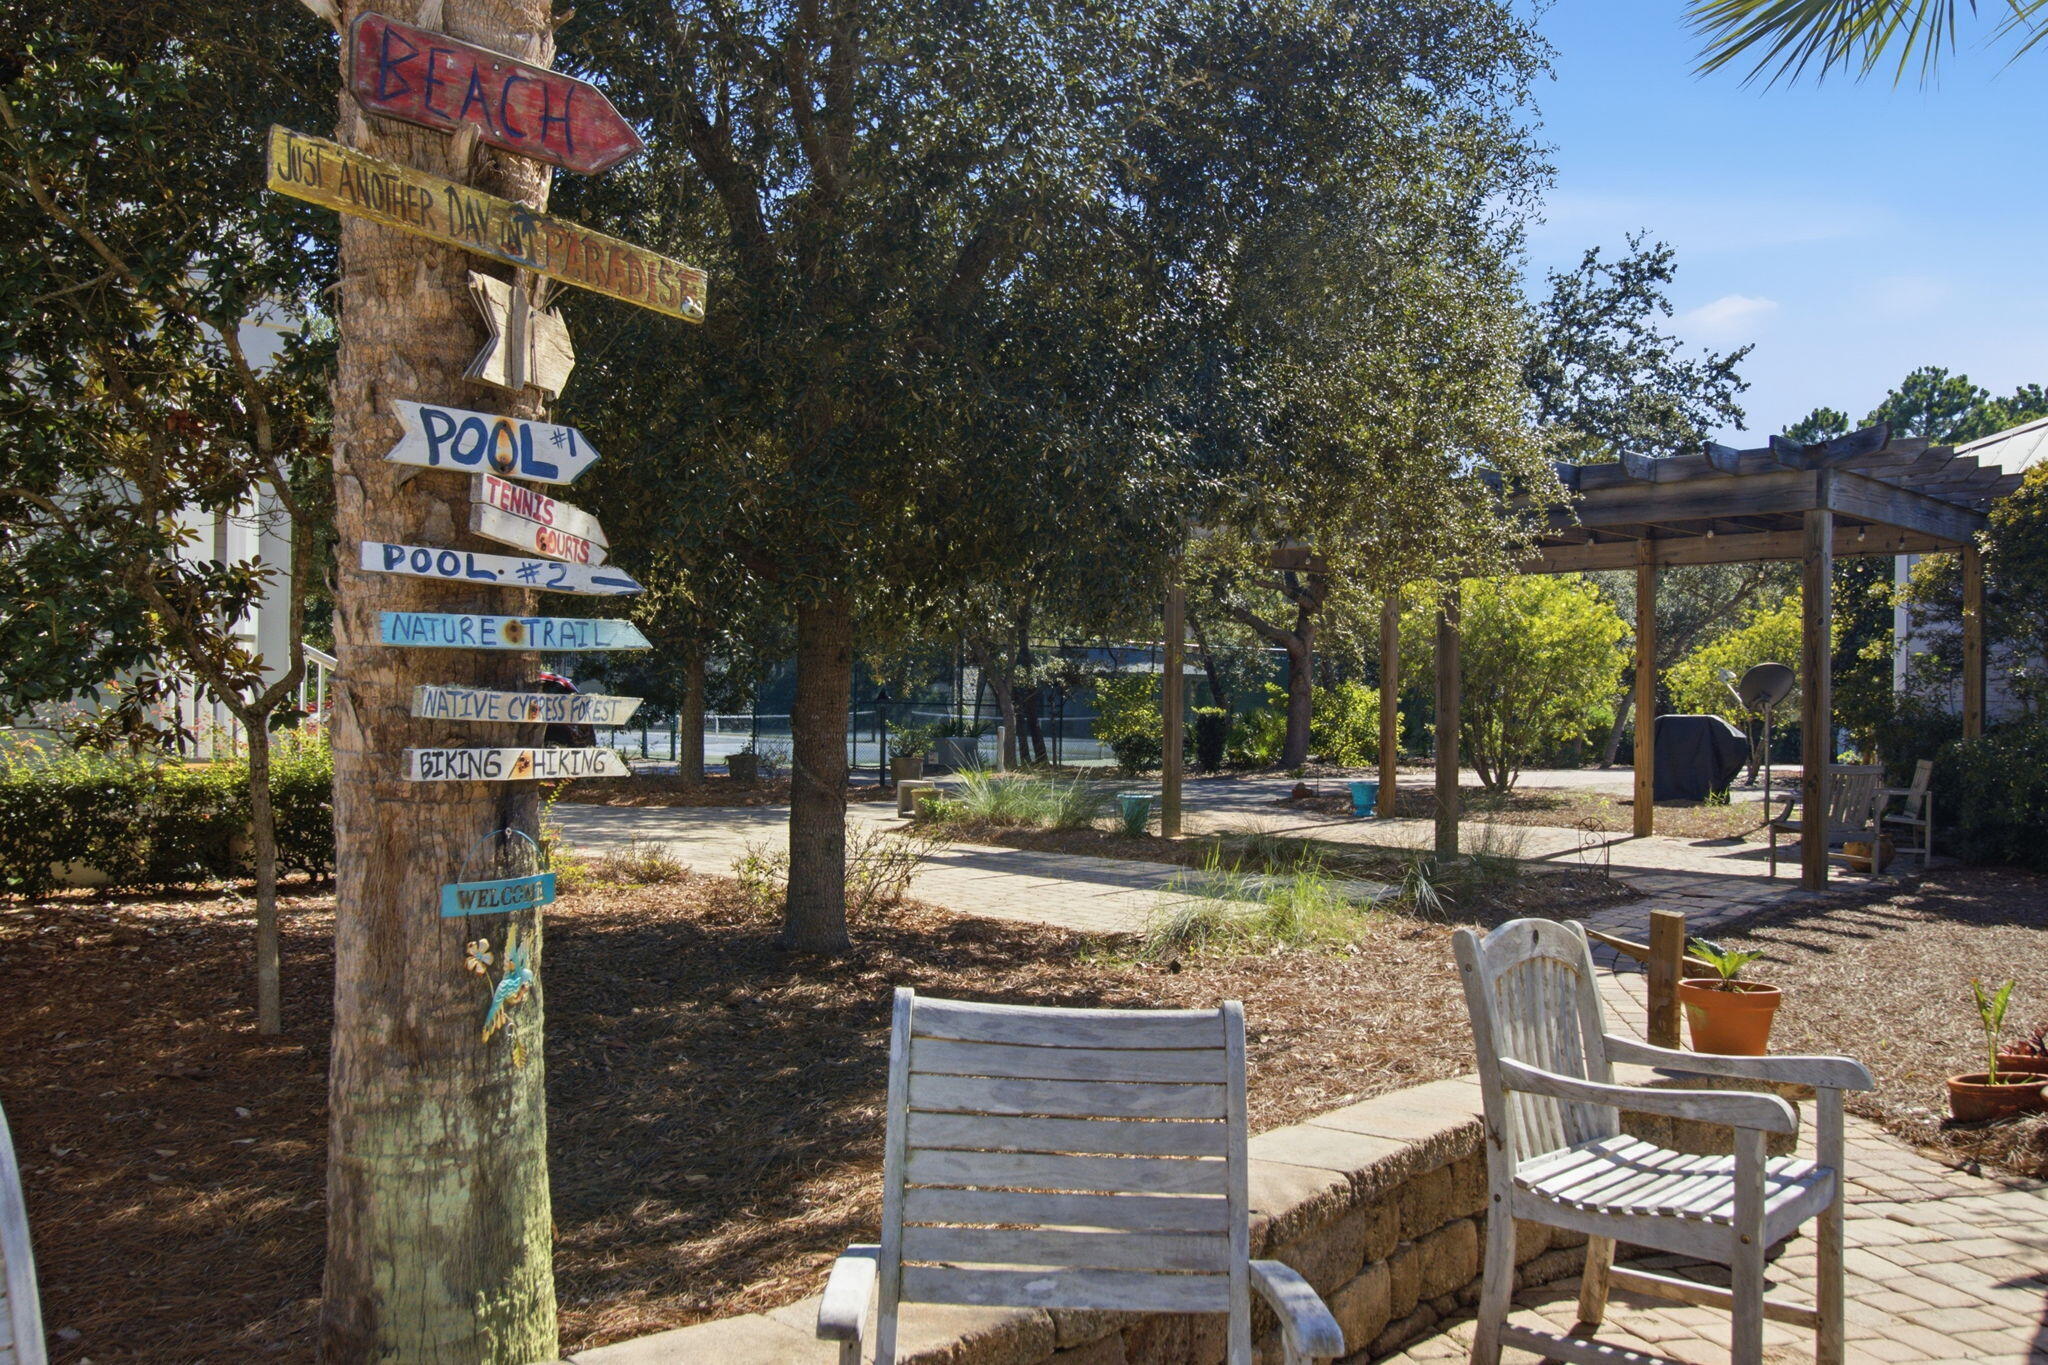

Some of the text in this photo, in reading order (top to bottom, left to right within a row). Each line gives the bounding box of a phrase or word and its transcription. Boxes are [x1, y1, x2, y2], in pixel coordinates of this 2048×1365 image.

[378, 24, 577, 157] BEACH
[276, 132, 323, 189] JUST
[338, 164, 435, 231] ANOTHER
[445, 186, 492, 248] DAY
[420, 406, 577, 480] POOL #1
[486, 476, 555, 525] TENNIS
[535, 526, 590, 563] COURTS
[383, 543, 576, 591] POOL #2
[391, 613, 612, 647] NATURE TRAIL
[424, 690, 622, 722] NATIVE CYPRESS FOREST
[419, 750, 501, 779] BIKING
[532, 750, 606, 777] HIKING
[457, 880, 544, 909] WELCOME
